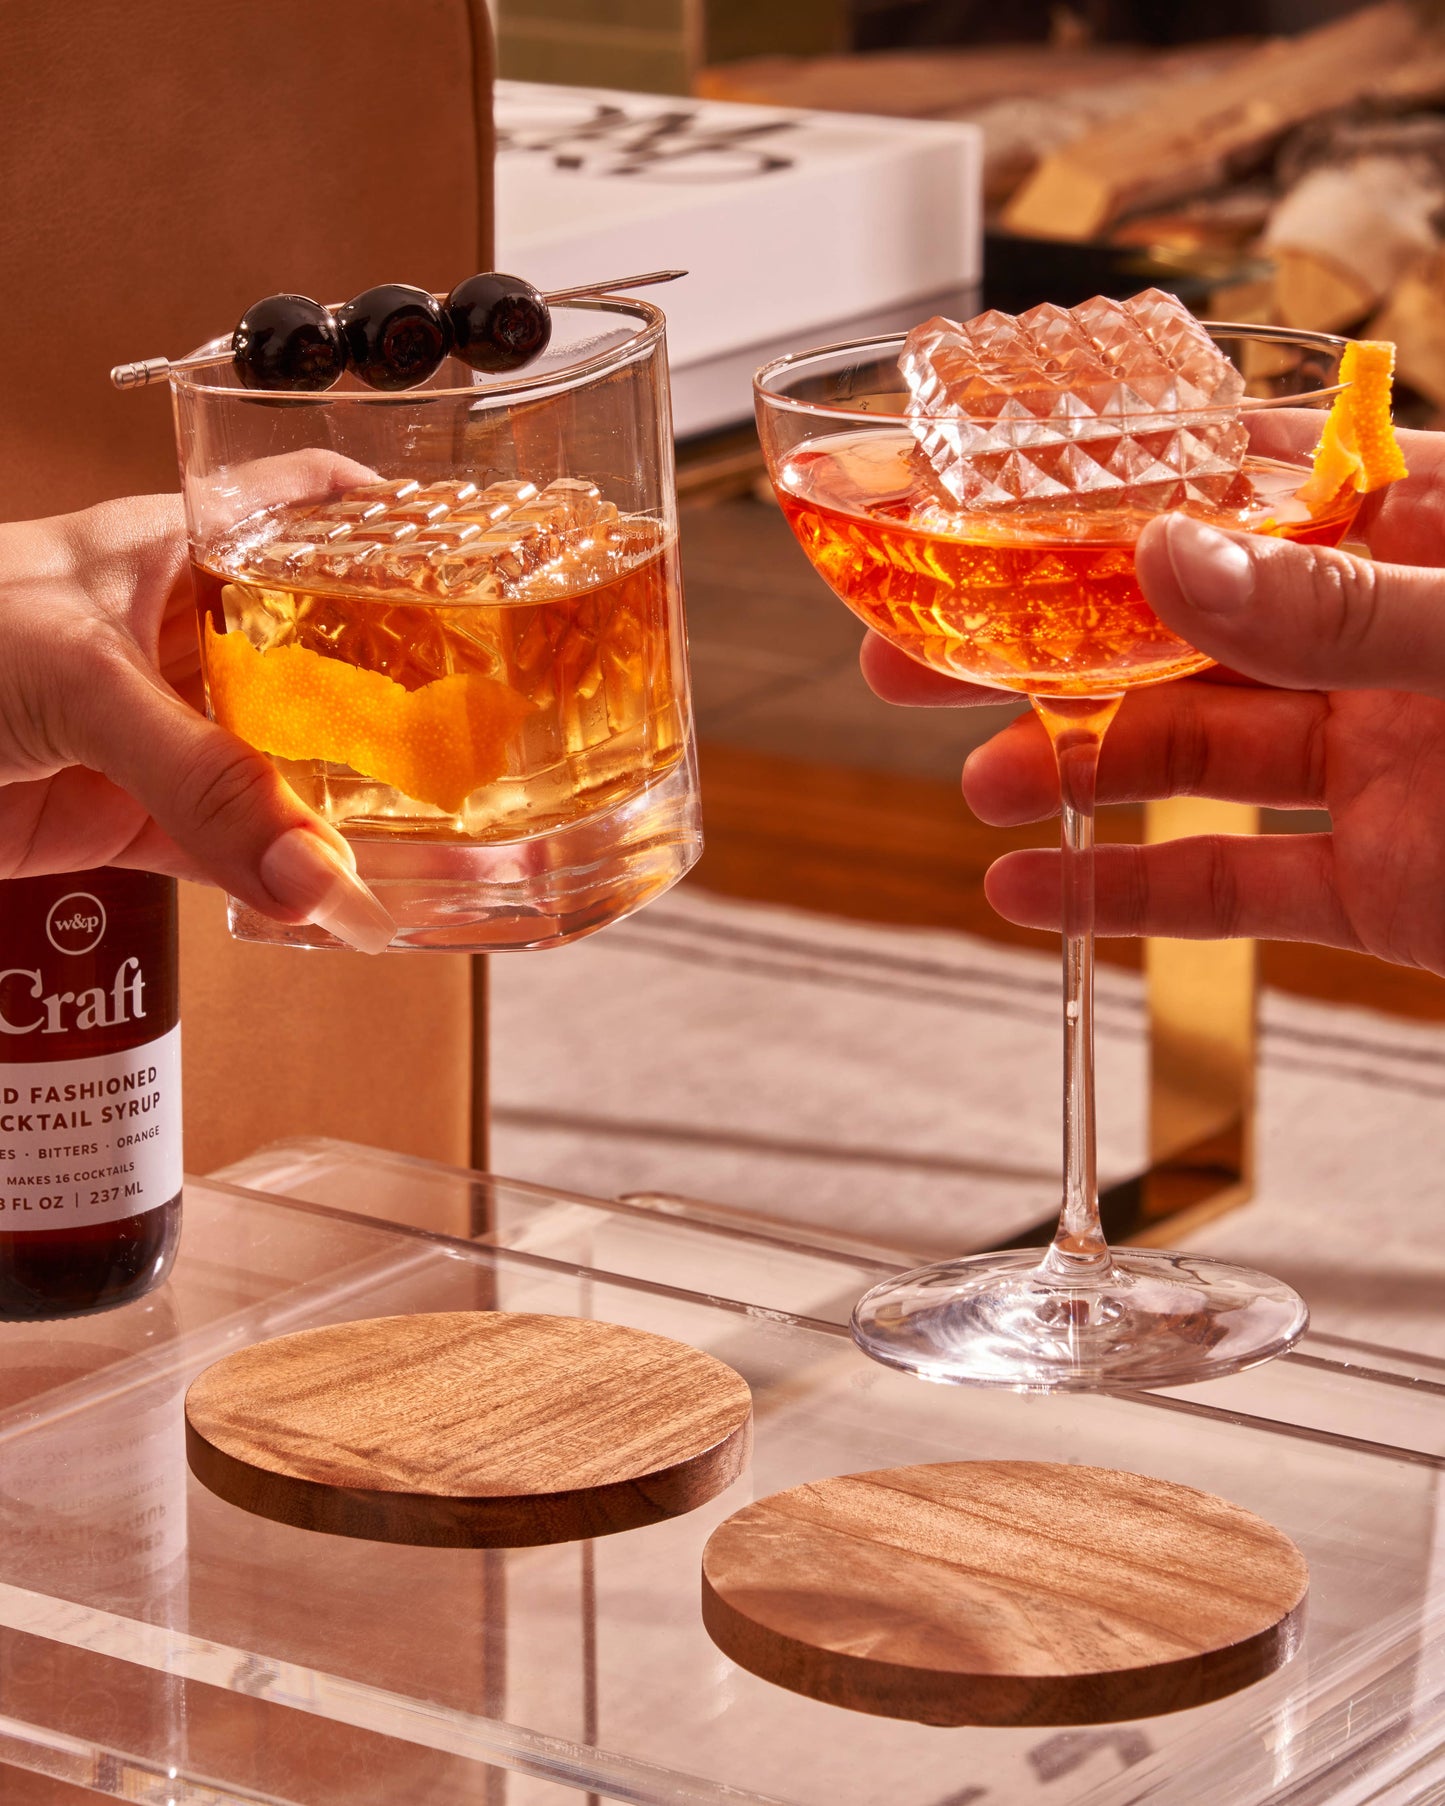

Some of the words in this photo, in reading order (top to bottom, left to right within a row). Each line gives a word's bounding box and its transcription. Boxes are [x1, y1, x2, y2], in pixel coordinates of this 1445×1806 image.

[55, 913, 99, 933] w&p
[0, 956, 147, 1035] Craft
[0, 1087, 19, 1104] D
[30, 1066, 157, 1104] FASHIONED
[101, 1091, 161, 1124] SYRUP
[38, 1143, 98, 1159] BITTERS
[117, 1125, 160, 1149] ORANGE
[6, 1175, 51, 1186] MAKES
[55, 1173, 70, 1184] 16
[74, 1161, 135, 1182] COCKTAILS
[12, 1197, 33, 1211] FL
[39, 1195, 64, 1210] OZ
[90, 1187, 120, 1205] 237
[124, 1181, 144, 1198] ML
